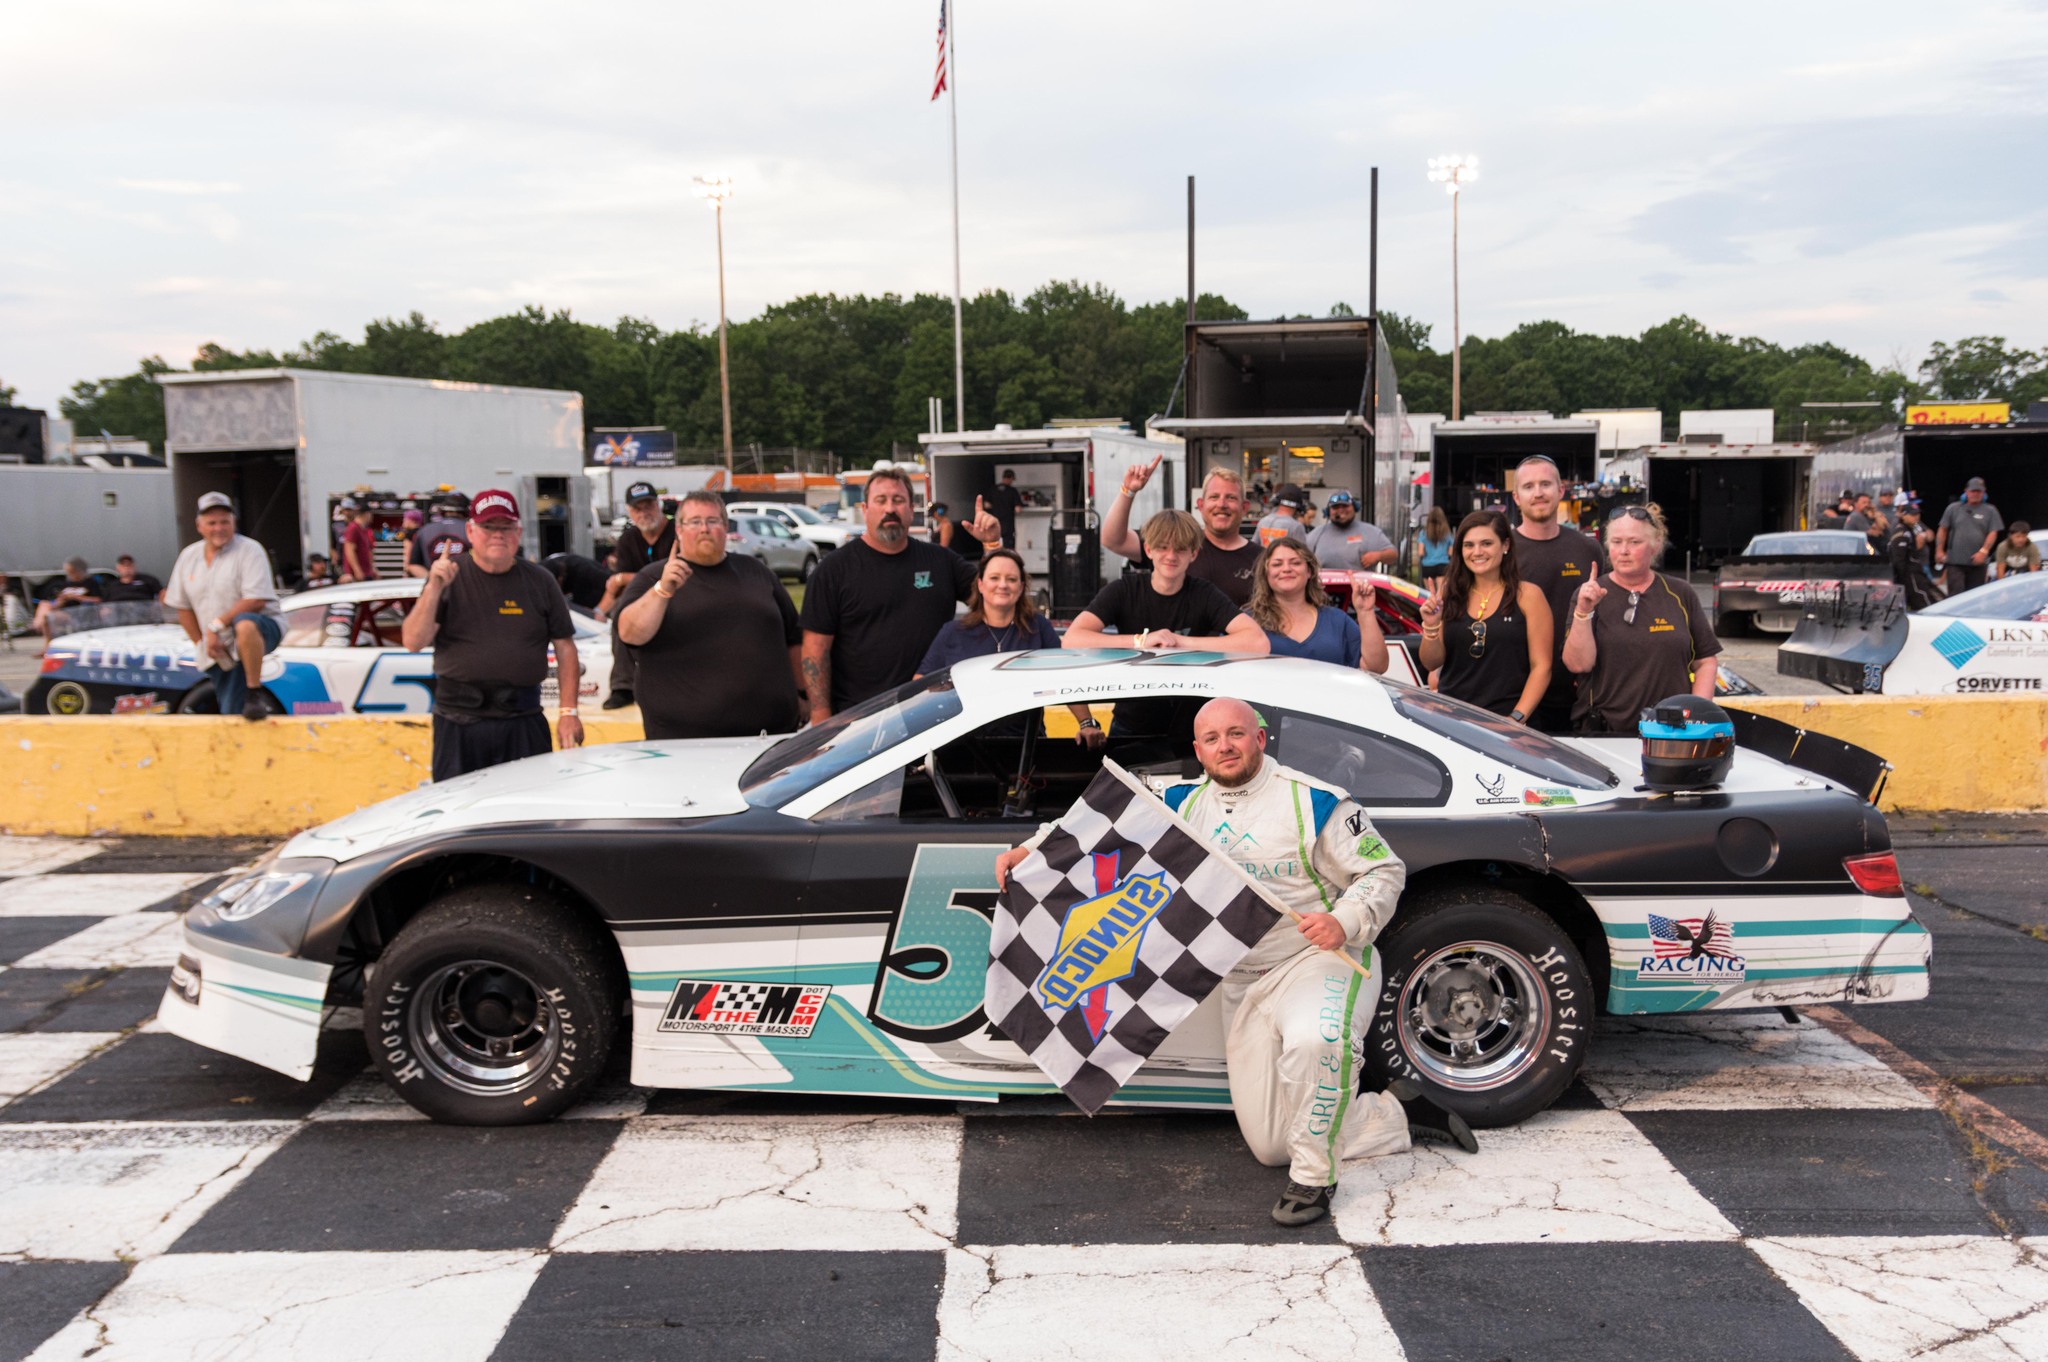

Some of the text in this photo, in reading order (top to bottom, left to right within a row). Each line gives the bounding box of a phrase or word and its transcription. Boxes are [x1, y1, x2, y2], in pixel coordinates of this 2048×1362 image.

[1989, 628, 2033, 642] LKN
[1060, 682, 1215, 695] DANIEL DEAN JR.
[1957, 677, 2042, 689] CORVETTE
[1237, 861, 1300, 880] RACE
[868, 843, 1012, 1043] 5
[1640, 956, 1746, 972] RACING
[790, 995, 823, 1025] COM
[1529, 946, 1584, 1064] Hoosier
[712, 1010, 758, 1023] THE
[662, 1021, 810, 1035] MOTORSPORT 4THE MASSES
[1308, 974, 1347, 1136] GRIT & GRACE
